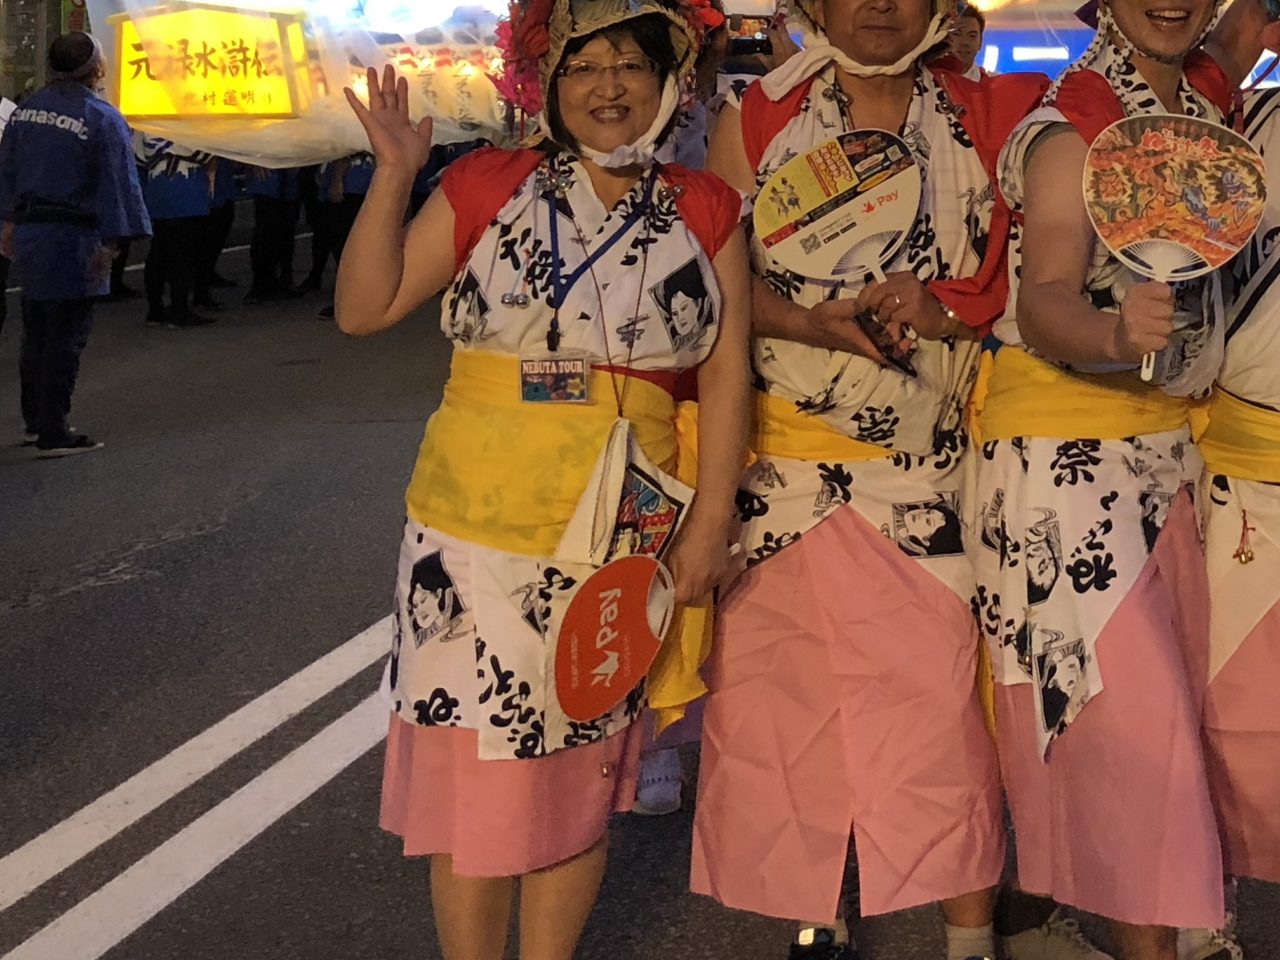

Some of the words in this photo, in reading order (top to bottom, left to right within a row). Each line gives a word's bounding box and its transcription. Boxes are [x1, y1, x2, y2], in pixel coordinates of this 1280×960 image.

[876, 189, 899, 207] Pay
[522, 361, 557, 374] NEBUTA
[558, 360, 583, 374] TOUR
[595, 587, 623, 650] Pay
